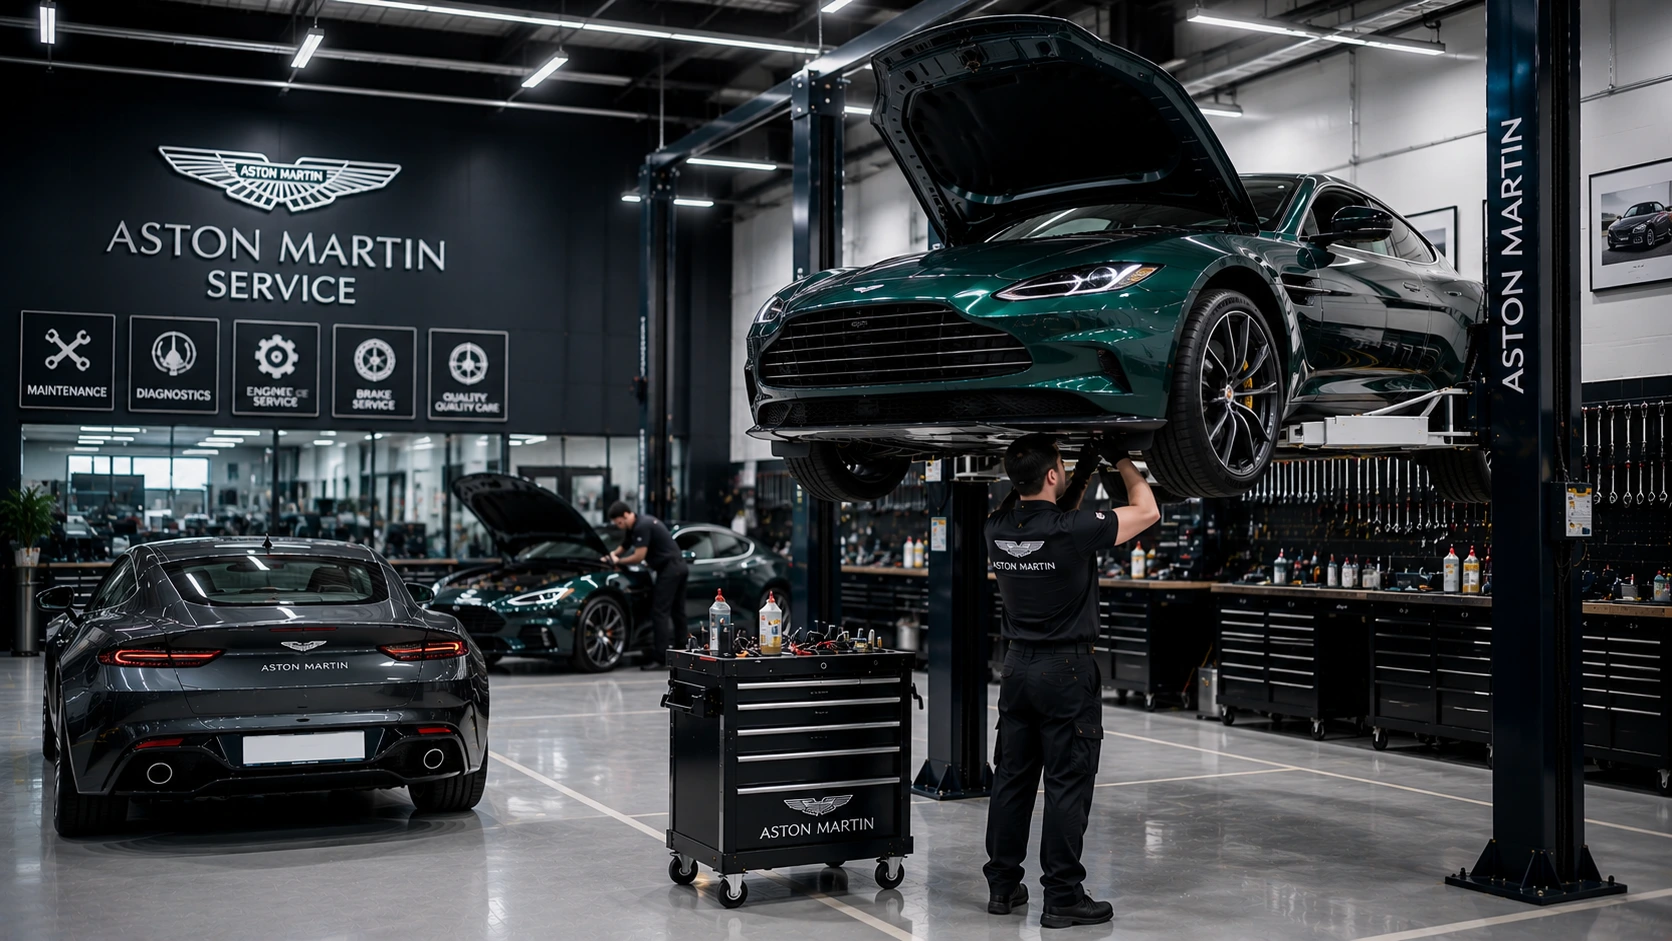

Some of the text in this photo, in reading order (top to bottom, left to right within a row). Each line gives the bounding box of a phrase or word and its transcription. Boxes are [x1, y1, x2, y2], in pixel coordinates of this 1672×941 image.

[240, 165, 323, 181] ASTON MARTIN
[106, 220, 445, 271] ASTON MARTIN
[1501, 117, 1524, 394] ASTON MARTIN
[207, 269, 356, 304] SERVICE
[27, 384, 107, 397] MAINTENANCE
[136, 388, 211, 401] DIAGNOSTICS
[356, 389, 392, 400] BRAKE
[253, 396, 298, 407] SERVICE
[442, 392, 488, 403] QUALITY
[352, 399, 395, 410] SERVICE
[435, 401, 475, 411] QUALITY
[1019, 561, 1056, 570] MARTIN
[261, 661, 348, 671] ASTON MARTIN
[759, 817, 874, 840] ASTON MARTIN
